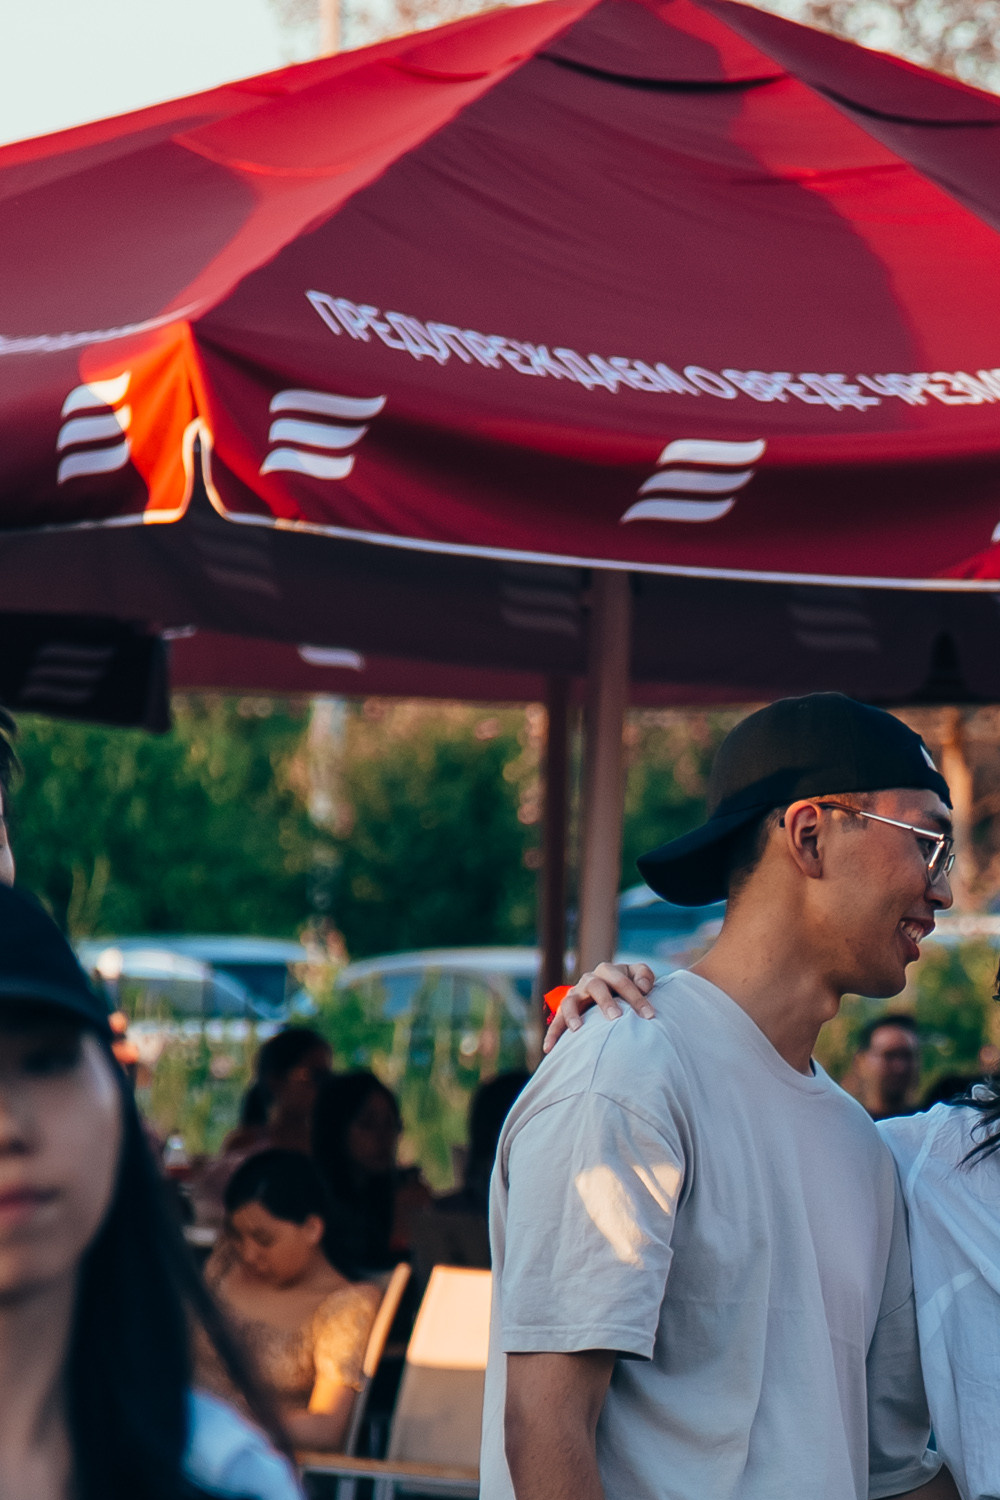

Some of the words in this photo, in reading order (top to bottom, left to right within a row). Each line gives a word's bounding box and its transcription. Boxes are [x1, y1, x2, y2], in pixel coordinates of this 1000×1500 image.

[305, 289, 700, 397] ПРЕДУПРЕЖДАЕМ
[682, 365, 738, 400] О
[721, 368, 882, 411] ВРЕДЕ
